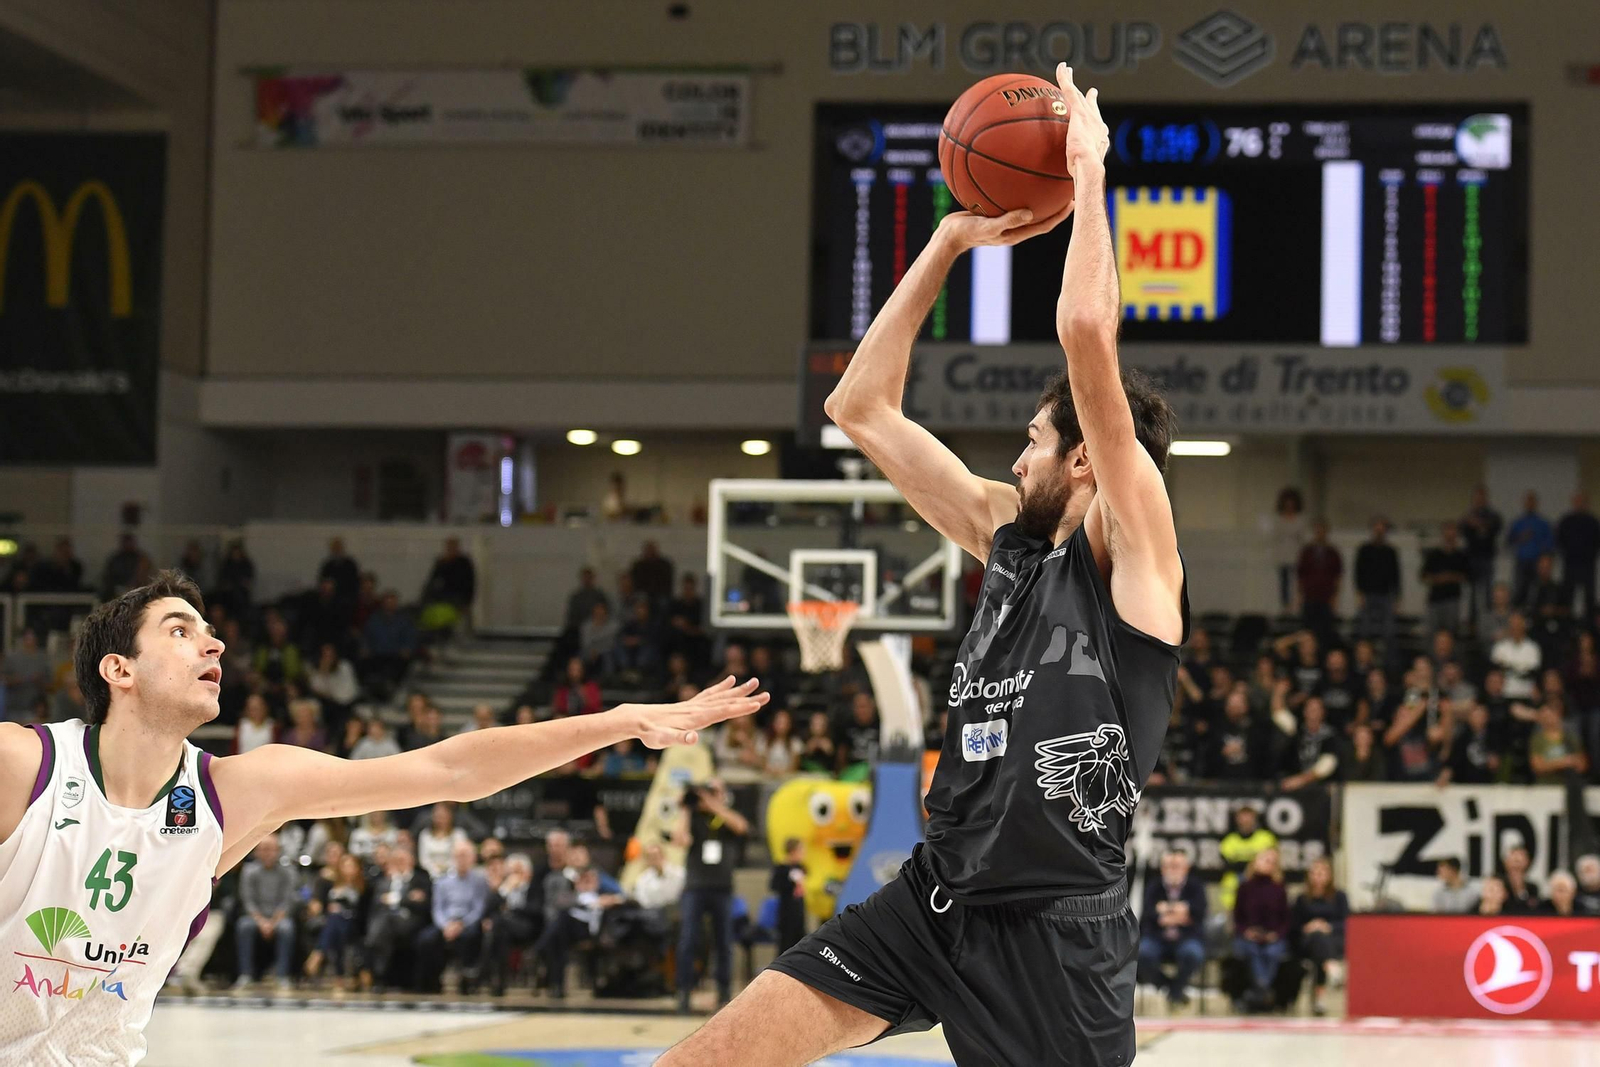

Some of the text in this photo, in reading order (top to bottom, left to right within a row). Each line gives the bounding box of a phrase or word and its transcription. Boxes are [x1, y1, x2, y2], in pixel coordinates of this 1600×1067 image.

[829, 22, 1507, 74] BLM GROUP ARENA
[1224, 127, 1264, 158] 76
[1126, 230, 1206, 271] MD
[1219, 355, 1259, 394] di
[1273, 355, 1411, 396] Trento
[84, 848, 138, 912] 43
